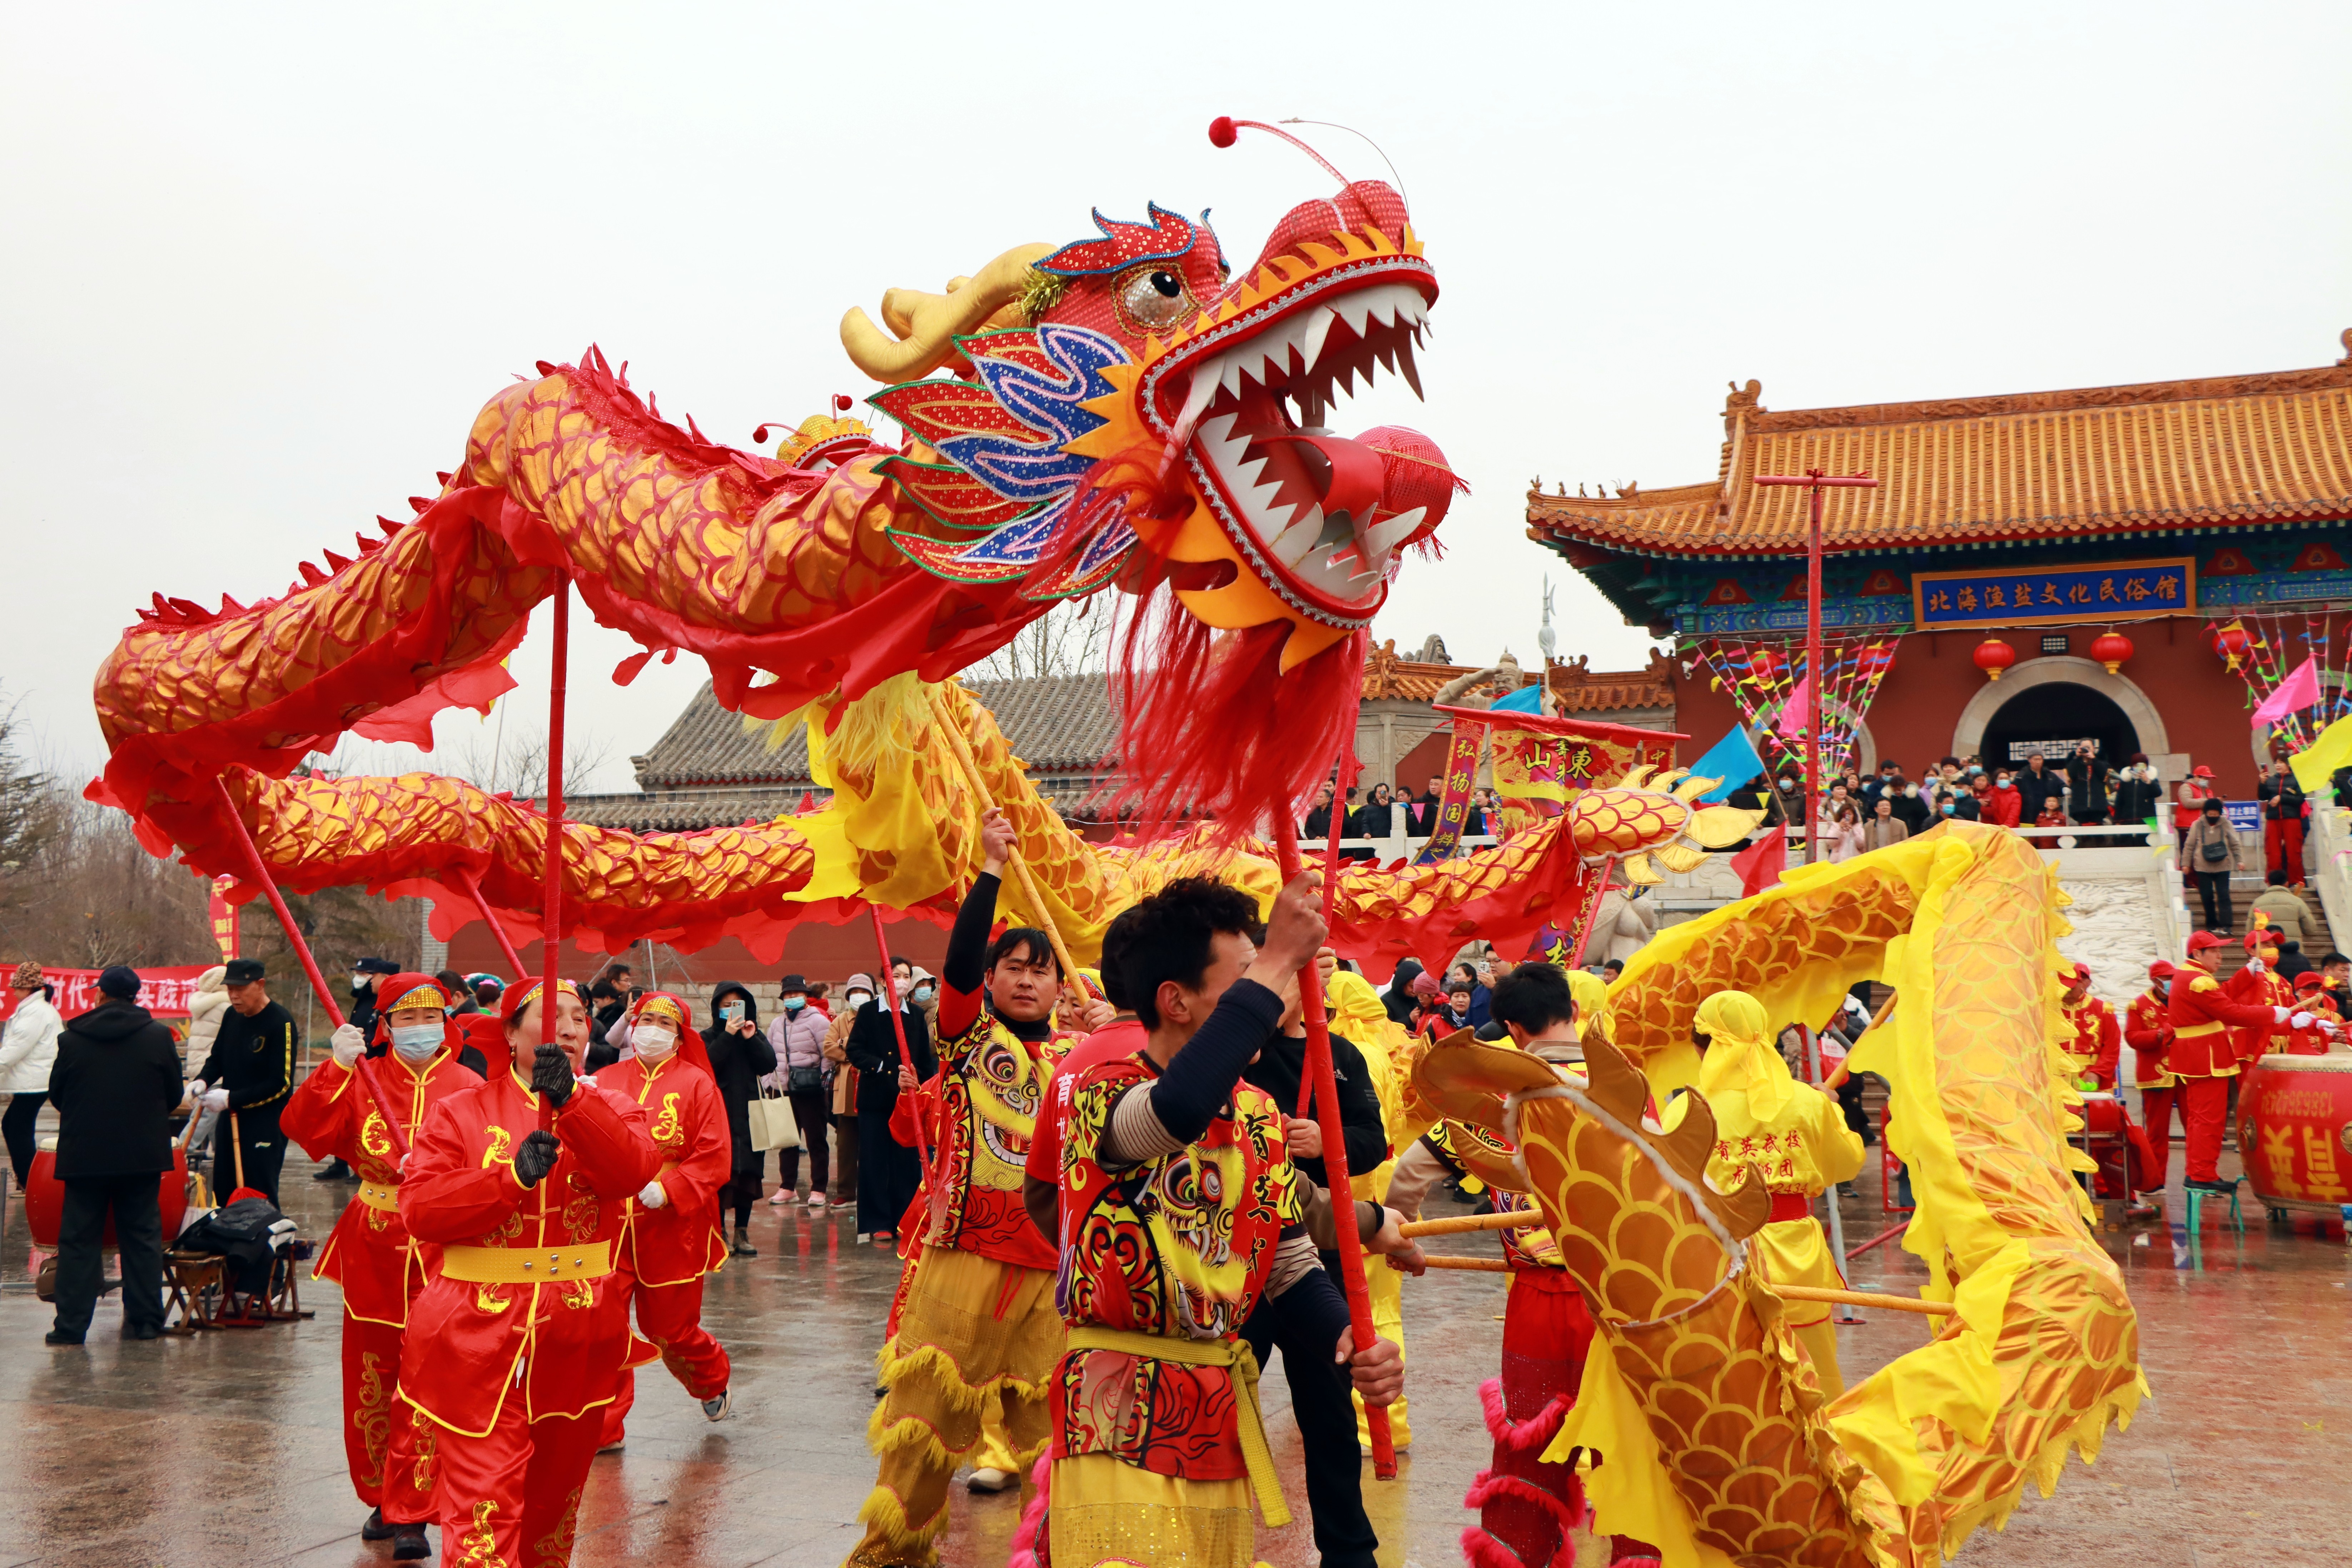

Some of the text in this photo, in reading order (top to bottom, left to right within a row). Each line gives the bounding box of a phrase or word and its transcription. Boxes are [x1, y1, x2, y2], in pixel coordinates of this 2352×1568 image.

[1929, 575, 2178, 612] 北海渔盐文化民俗馆
[1333, 1073, 1348, 1081] didas
[1714, 1130, 1802, 1161] 育英武校
[2264, 1124, 2349, 1201] 育英
